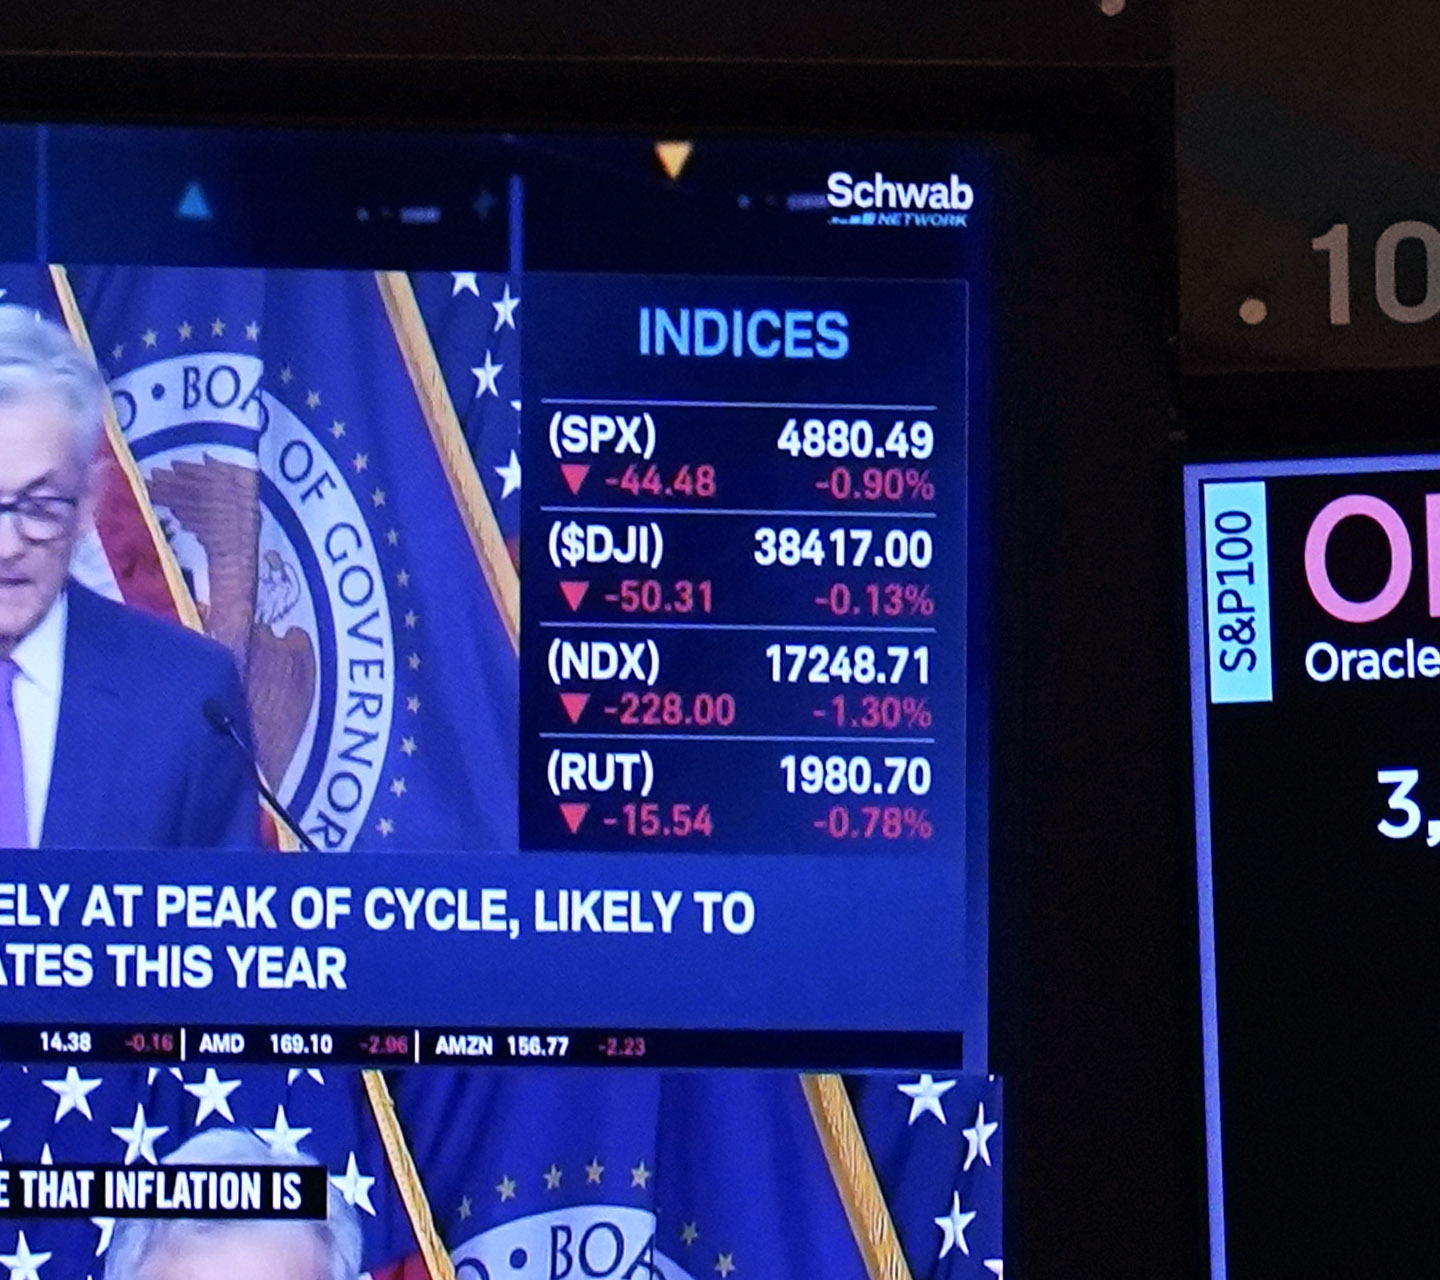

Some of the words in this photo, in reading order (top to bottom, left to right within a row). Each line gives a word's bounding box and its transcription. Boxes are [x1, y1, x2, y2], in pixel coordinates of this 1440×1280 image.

[826, 172, 974, 211] Schwab
[1312, 220, 1440, 326] 10
[638, 307, 850, 359] INDICES
[549, 411, 657, 459] (SPX)
[776, 418, 935, 460] 4880.49
[605, 464, 717, 498] -44.48
[548, 521, 664, 570] ($DJI)
[753, 527, 933, 569] 38417.00
[604, 580, 713, 613] -50.31
[1214, 510, 1257, 673] S&P100
[547, 637, 660, 685] (NDX)
[765, 644, 930, 685] 17248.71
[1305, 637, 1440, 682] Oracle
[604, 693, 736, 727] -228.00
[547, 748, 655, 797] (RUT)
[780, 754, 932, 795] 1980.70
[603, 803, 714, 838] -15.54
[80, 884, 143, 927] AT
[155, 885, 278, 929] PEAK
[290, 886, 352, 930] OF
[363, 887, 520, 939] CYCLE,
[534, 889, 682, 933] LIKELY
[693, 891, 756, 934] TO
[106, 945, 214, 989] THIS
[226, 946, 348, 990] YEAR
[19, 1170, 94, 1210] THAT
[104, 1171, 261, 1211] INFLATION
[271, 1172, 302, 1212] IS
